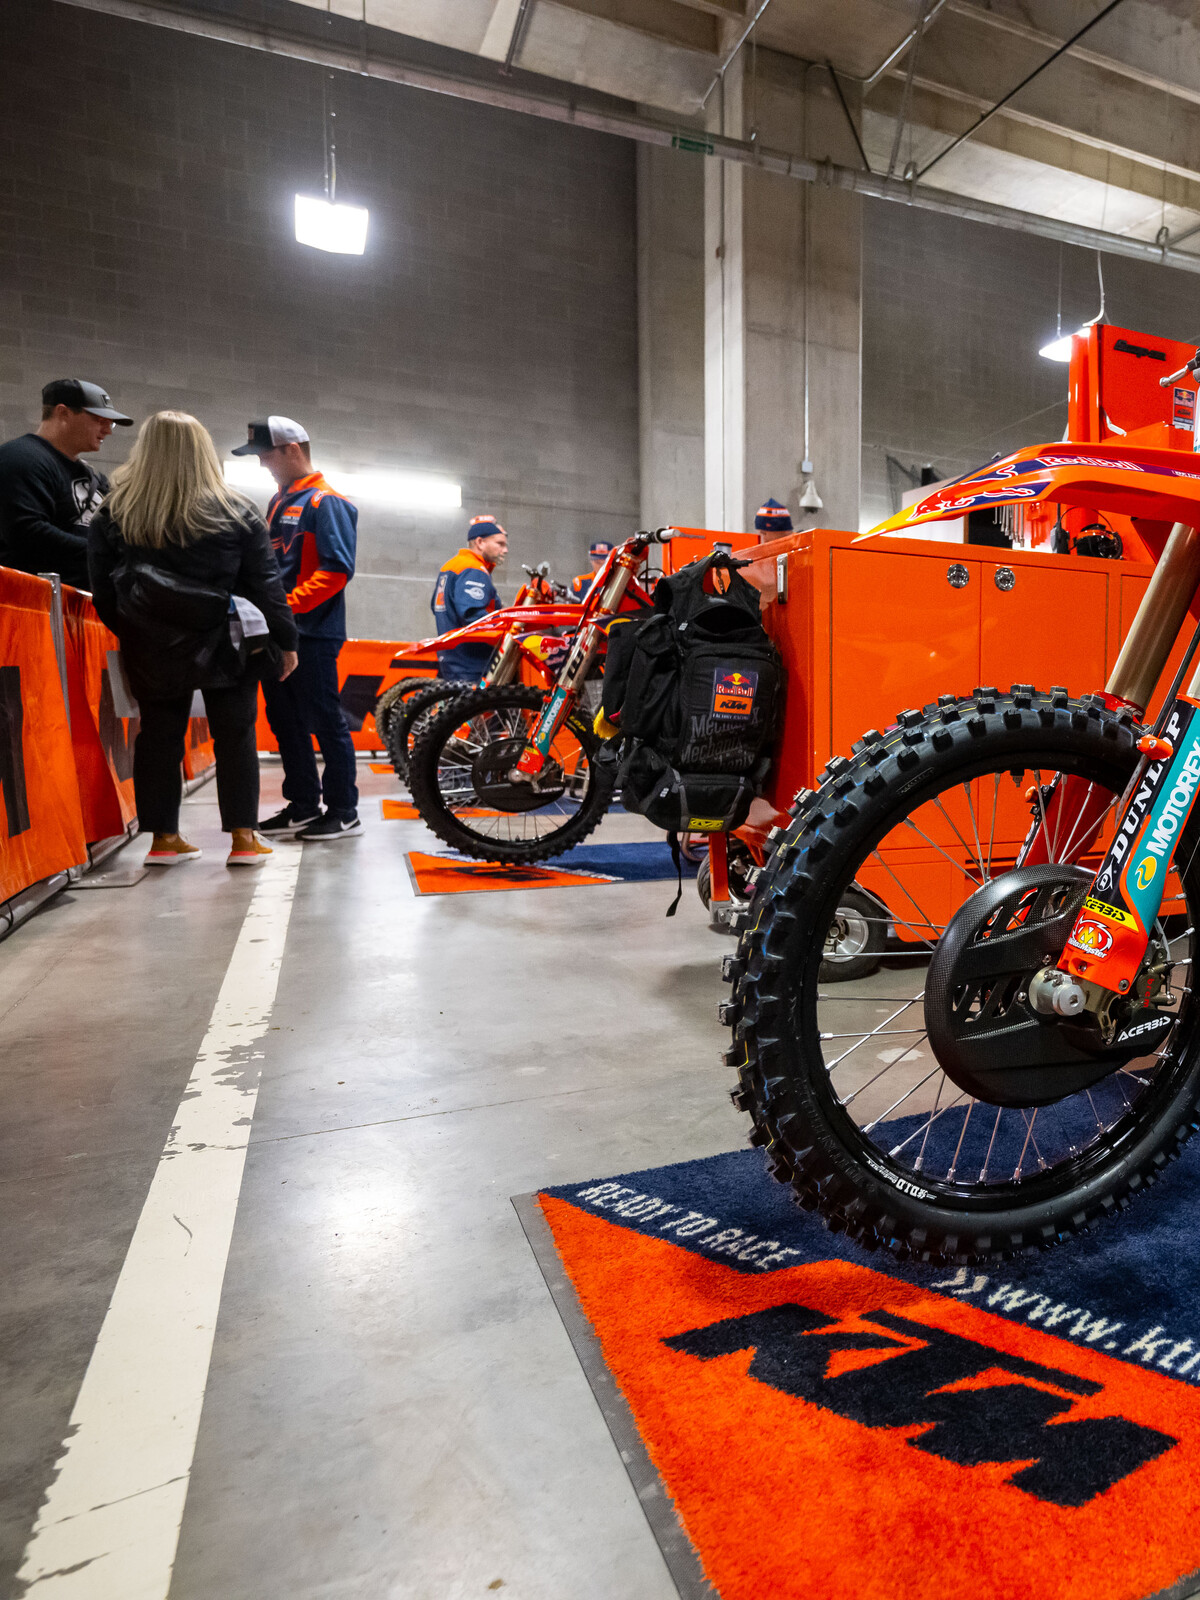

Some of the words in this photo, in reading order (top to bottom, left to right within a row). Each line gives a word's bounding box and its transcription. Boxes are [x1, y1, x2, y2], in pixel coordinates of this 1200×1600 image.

[720, 700, 748, 710] KTM
[1111, 711, 1180, 864] DUNLP
[576, 1182, 684, 1222] READY
[660, 1211, 718, 1236] TO
[699, 1228, 800, 1270] RACE
[660, 1302, 1181, 1508] KTM
